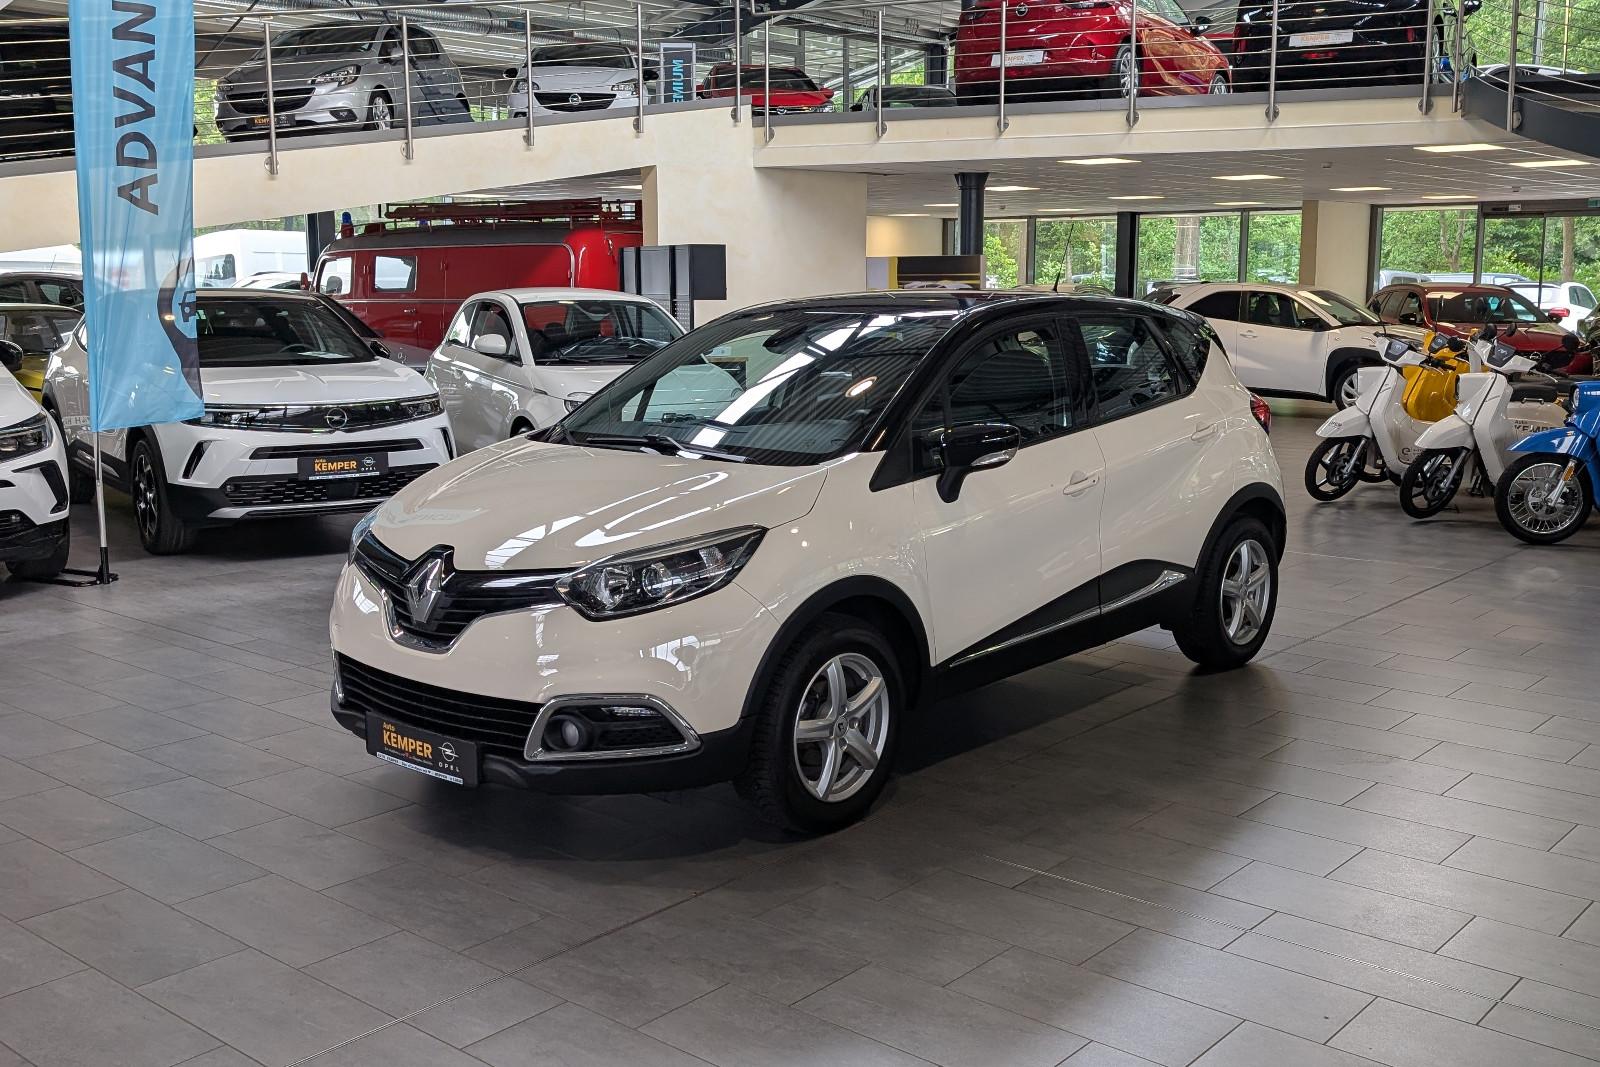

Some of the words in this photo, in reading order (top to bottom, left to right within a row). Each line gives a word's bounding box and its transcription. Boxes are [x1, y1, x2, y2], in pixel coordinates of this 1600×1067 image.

[111, 0, 159, 216] ADVAN
[314, 461, 357, 471] KEMPER
[383, 722, 396, 732] Auto
[383, 730, 433, 759] KEMPER
[438, 761, 460, 772] OPEL
